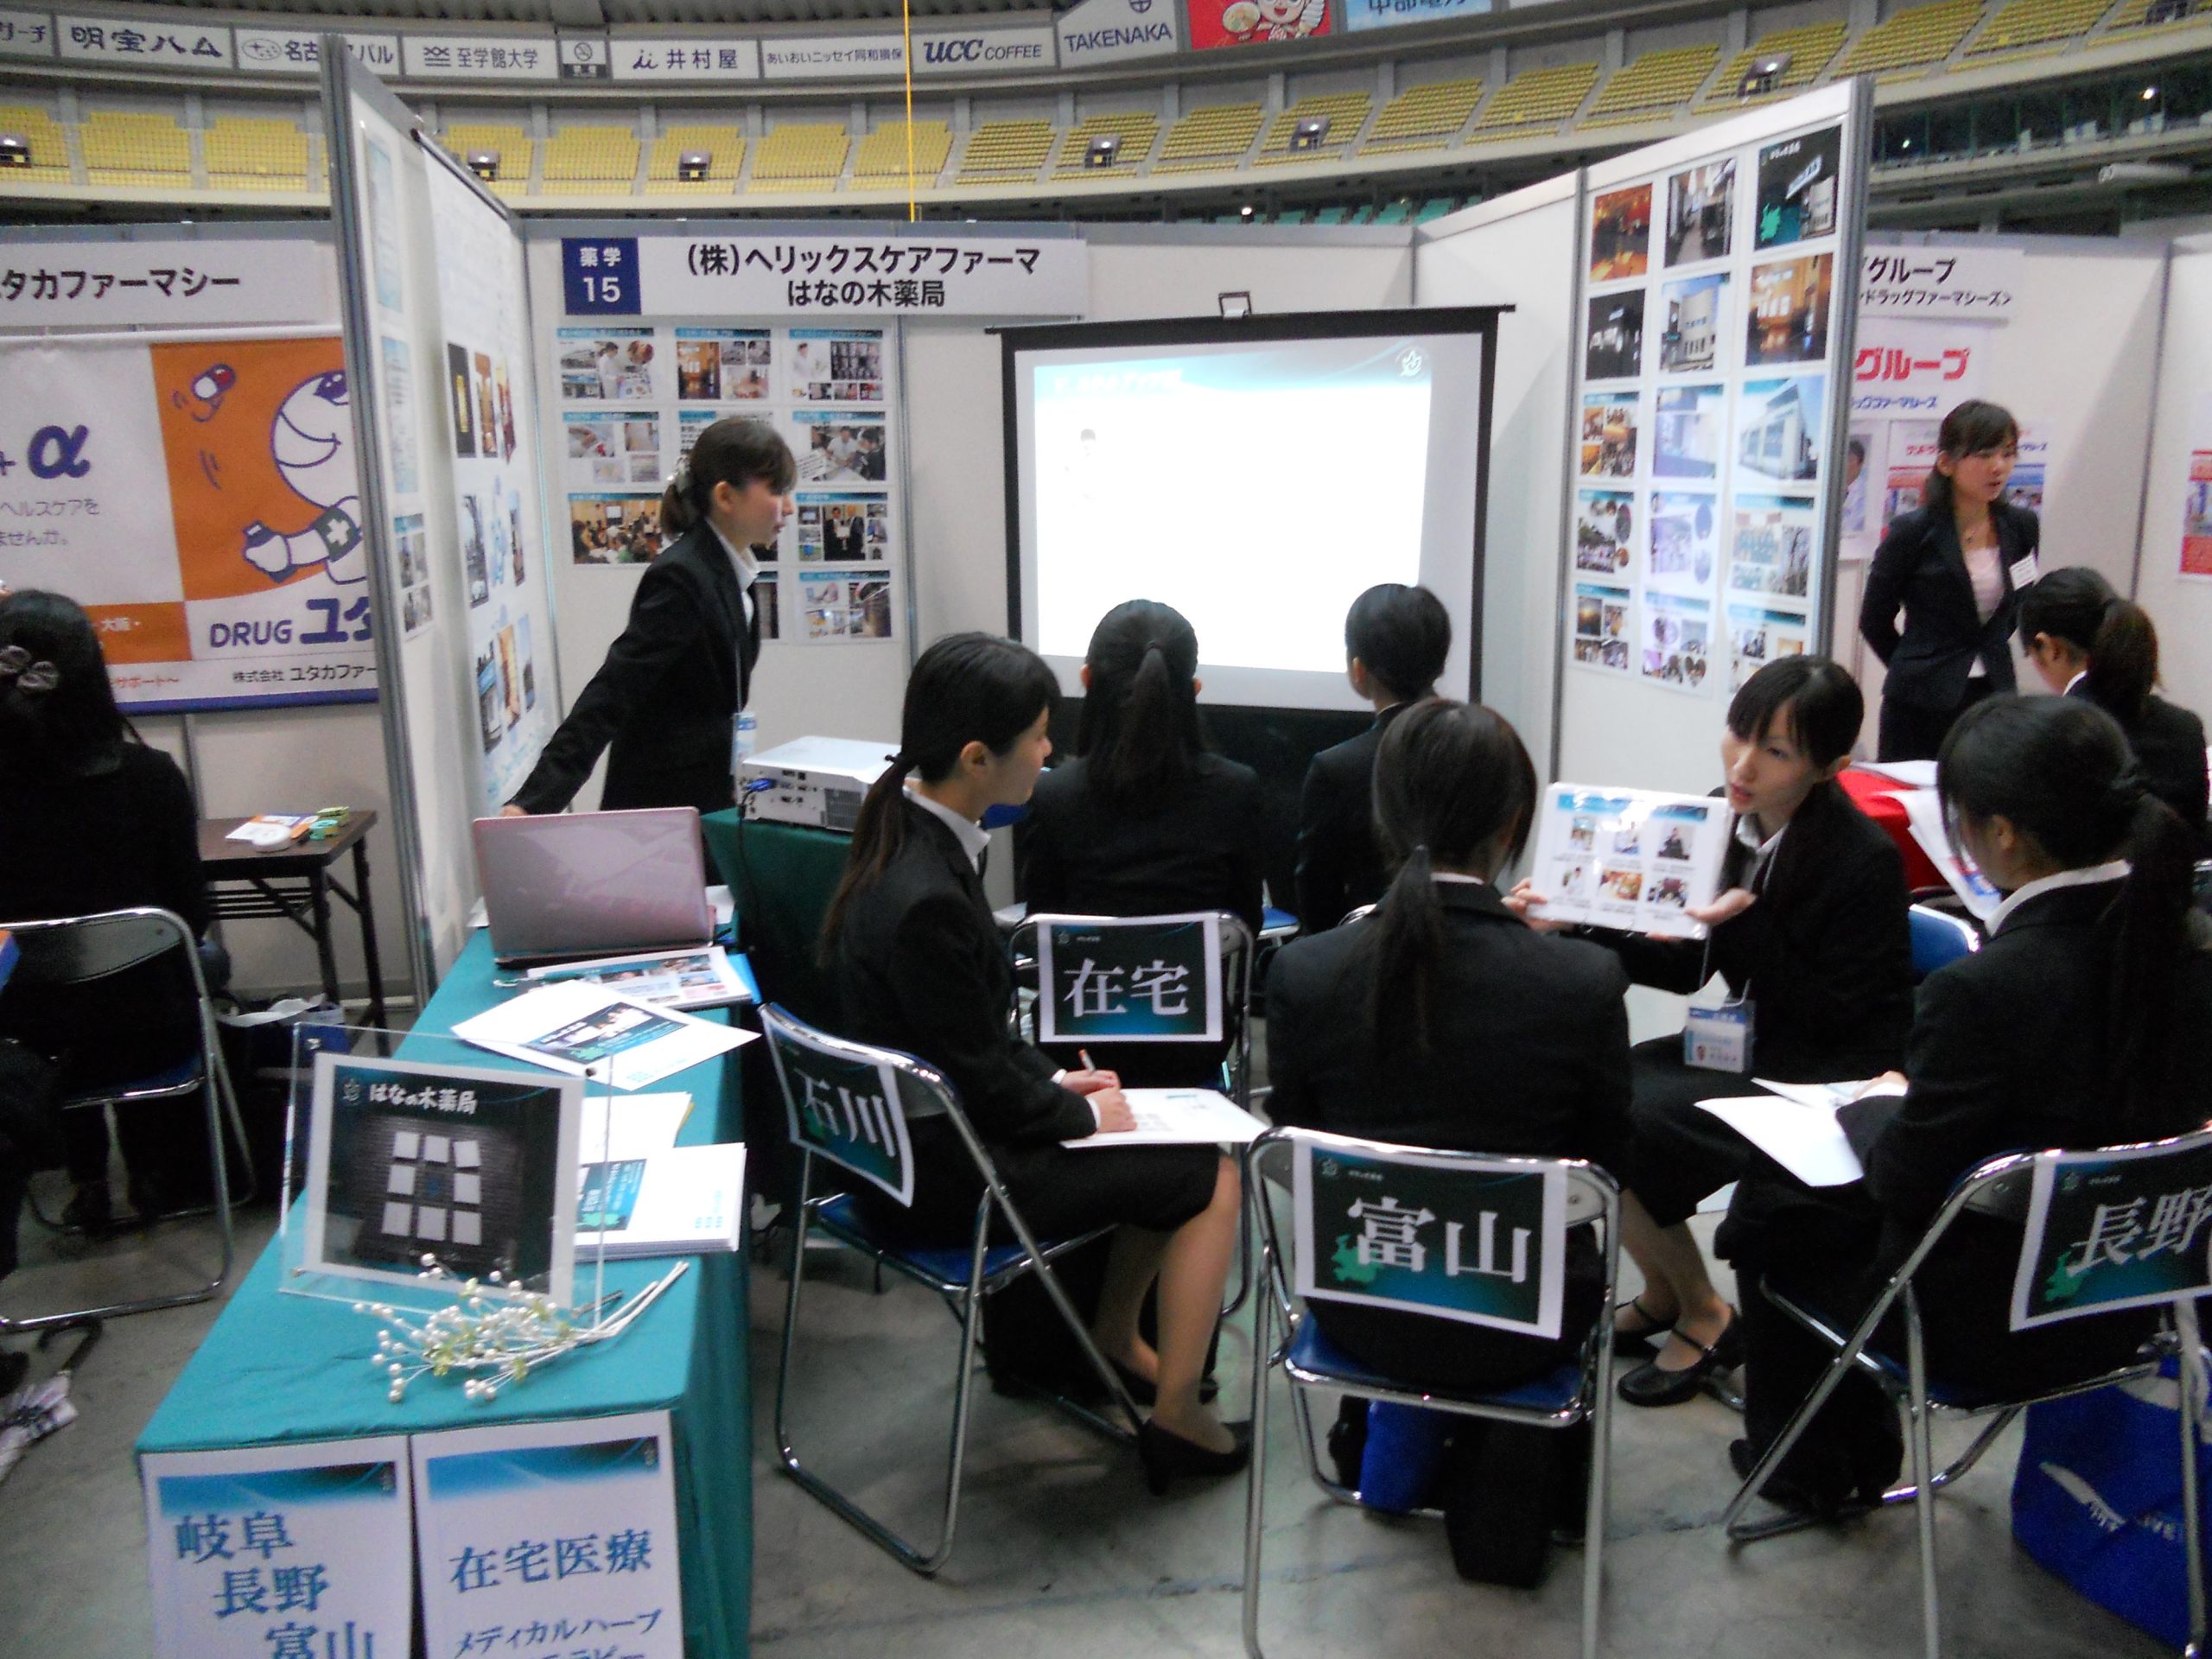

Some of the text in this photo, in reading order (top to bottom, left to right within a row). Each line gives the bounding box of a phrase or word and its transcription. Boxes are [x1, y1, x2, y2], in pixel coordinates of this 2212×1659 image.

[71, 27, 222, 58] 明宝ハム
[984, 44, 1042, 60] COFFEE
[1064, 23, 1173, 53] TAKENAKA
[457, 48, 538, 68] 至学館大学
[666, 48, 738, 70] 井村屋
[580, 246, 622, 266] 薬学
[688, 244, 1041, 276] (株)ヘリックスケアファーマ
[1862, 257, 1956, 284] グループ
[0, 268, 240, 301] タカファーマシー
[582, 277, 620, 303] 15
[788, 280, 945, 308] はなの木薬局
[1854, 346, 1971, 381] グループ
[210, 611, 292, 648] DRUG
[232, 671, 284, 683] 株式会社
[1063, 957, 1189, 1017] 在宅
[369, 1083, 479, 1116] はなの木薬局
[793, 1067, 896, 1157] 石川
[1347, 1196, 1533, 1284] 富山
[2066, 1182, 2212, 1278] 長野
[176, 1511, 294, 1565] 岐阜
[449, 1529, 653, 1594] 在宅医療
[213, 1563, 330, 1620] 長野
